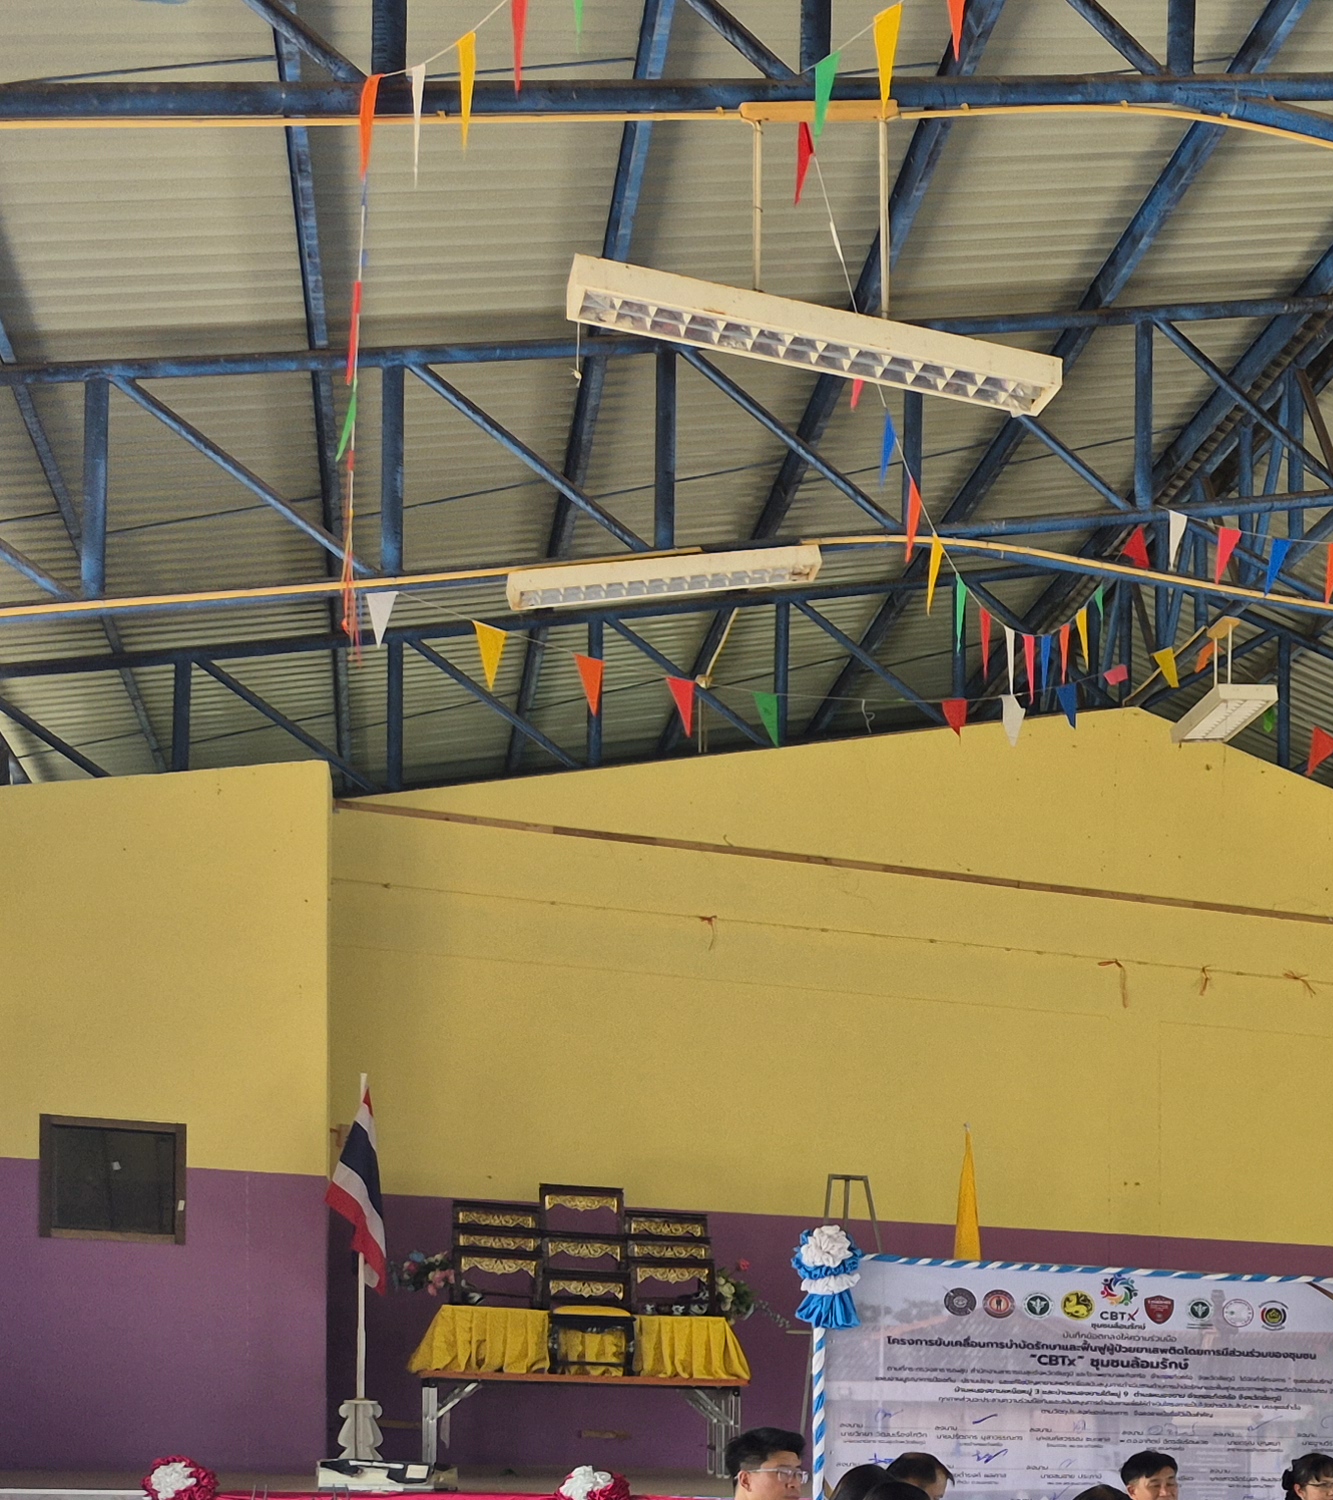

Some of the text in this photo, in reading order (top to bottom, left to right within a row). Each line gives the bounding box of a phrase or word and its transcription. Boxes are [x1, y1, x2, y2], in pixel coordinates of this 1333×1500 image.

[1090, 1356, 1190, 1371] ชุมชนล้อมรักษ์
